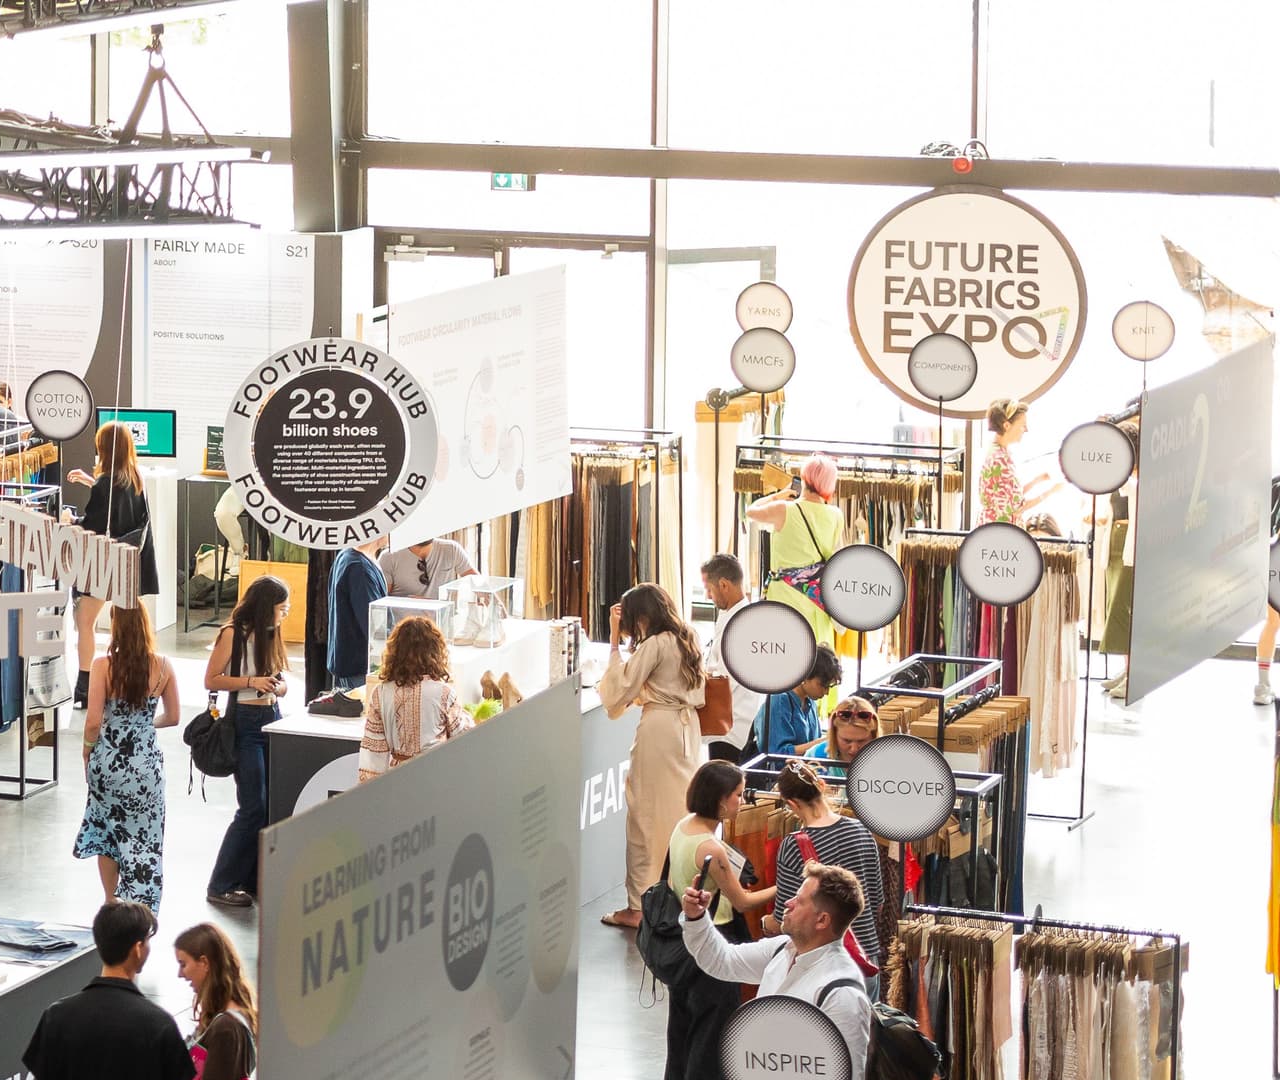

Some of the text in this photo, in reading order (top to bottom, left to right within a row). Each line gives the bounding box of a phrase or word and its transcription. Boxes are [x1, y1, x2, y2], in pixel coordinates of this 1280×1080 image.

[153, 238, 245, 255] FAIRLY MADE
[285, 244, 309, 258] S21
[153, 258, 177, 267] ABOUT
[884, 239, 1040, 275] FUTURE
[884, 275, 1041, 311] FABRICS
[747, 306, 781, 318] YARNS
[153, 330, 225, 341] POSITIVE SOLUTIONS
[882, 310, 1048, 360] EXPO
[1131, 325, 1156, 336] KNIT
[741, 354, 784, 367] MMCFs
[913, 361, 972, 373] COMPONENTS
[233, 343, 428, 420] FOOTWEAR HUB
[33, 392, 84, 405] COTTON
[288, 387, 373, 420] 23.9
[35, 406, 83, 419] WOVEN
[282, 423, 378, 437] billion shoes
[1080, 450, 1112, 464] LUXE
[234, 472, 381, 545] FOOTWEAR
[981, 548, 1020, 562] FAUX
[984, 565, 1016, 578] SKIN
[832, 579, 892, 598] ALT SKIN
[750, 640, 786, 655] SKIN
[857, 779, 945, 797] DISCOVER
[302, 814, 436, 916] LEARNING FROM
[447, 868, 489, 938] BIO
[300, 868, 436, 997] NATURE
[447, 925, 489, 963] DESIGN
[745, 1050, 827, 1076] INSPIRE
